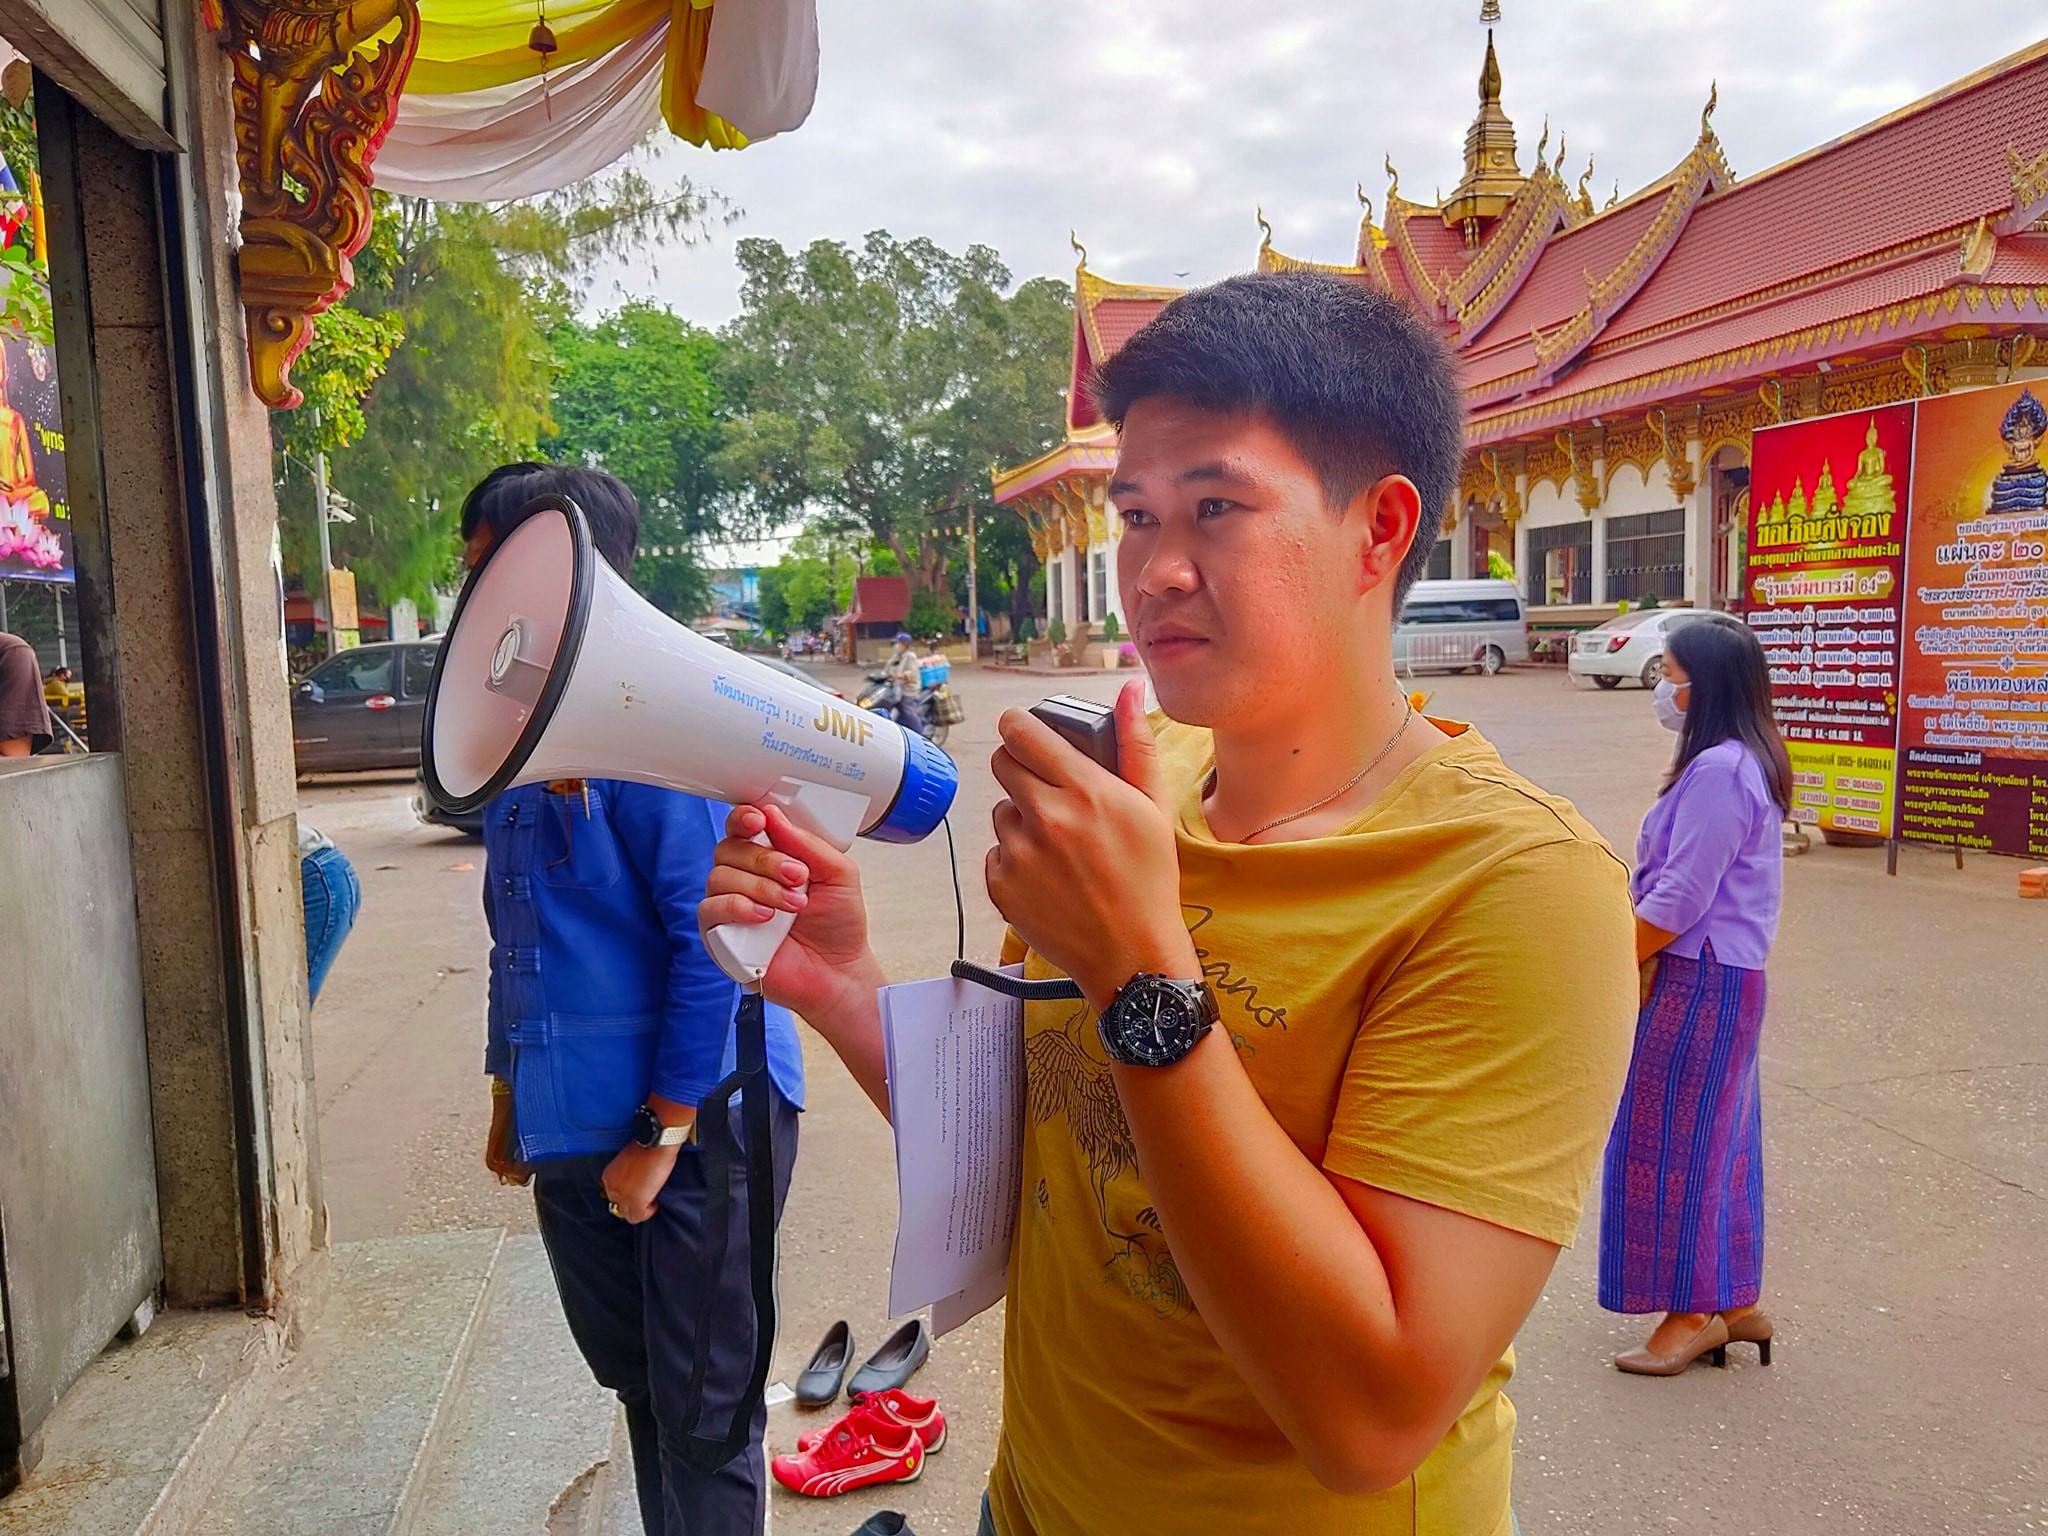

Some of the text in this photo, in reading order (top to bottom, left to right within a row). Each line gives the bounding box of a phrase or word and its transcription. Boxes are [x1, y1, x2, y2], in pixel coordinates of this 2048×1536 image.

[1757, 503, 1892, 547] ขอเชิญสั่งจอง
[1937, 540, 2044, 562] แผ่นละ ๒๐
[712, 675, 804, 729] พัฒนากรรุ่น 112
[813, 703, 874, 747] JMF
[761, 731, 833, 769] ทีมภาคสนาม
